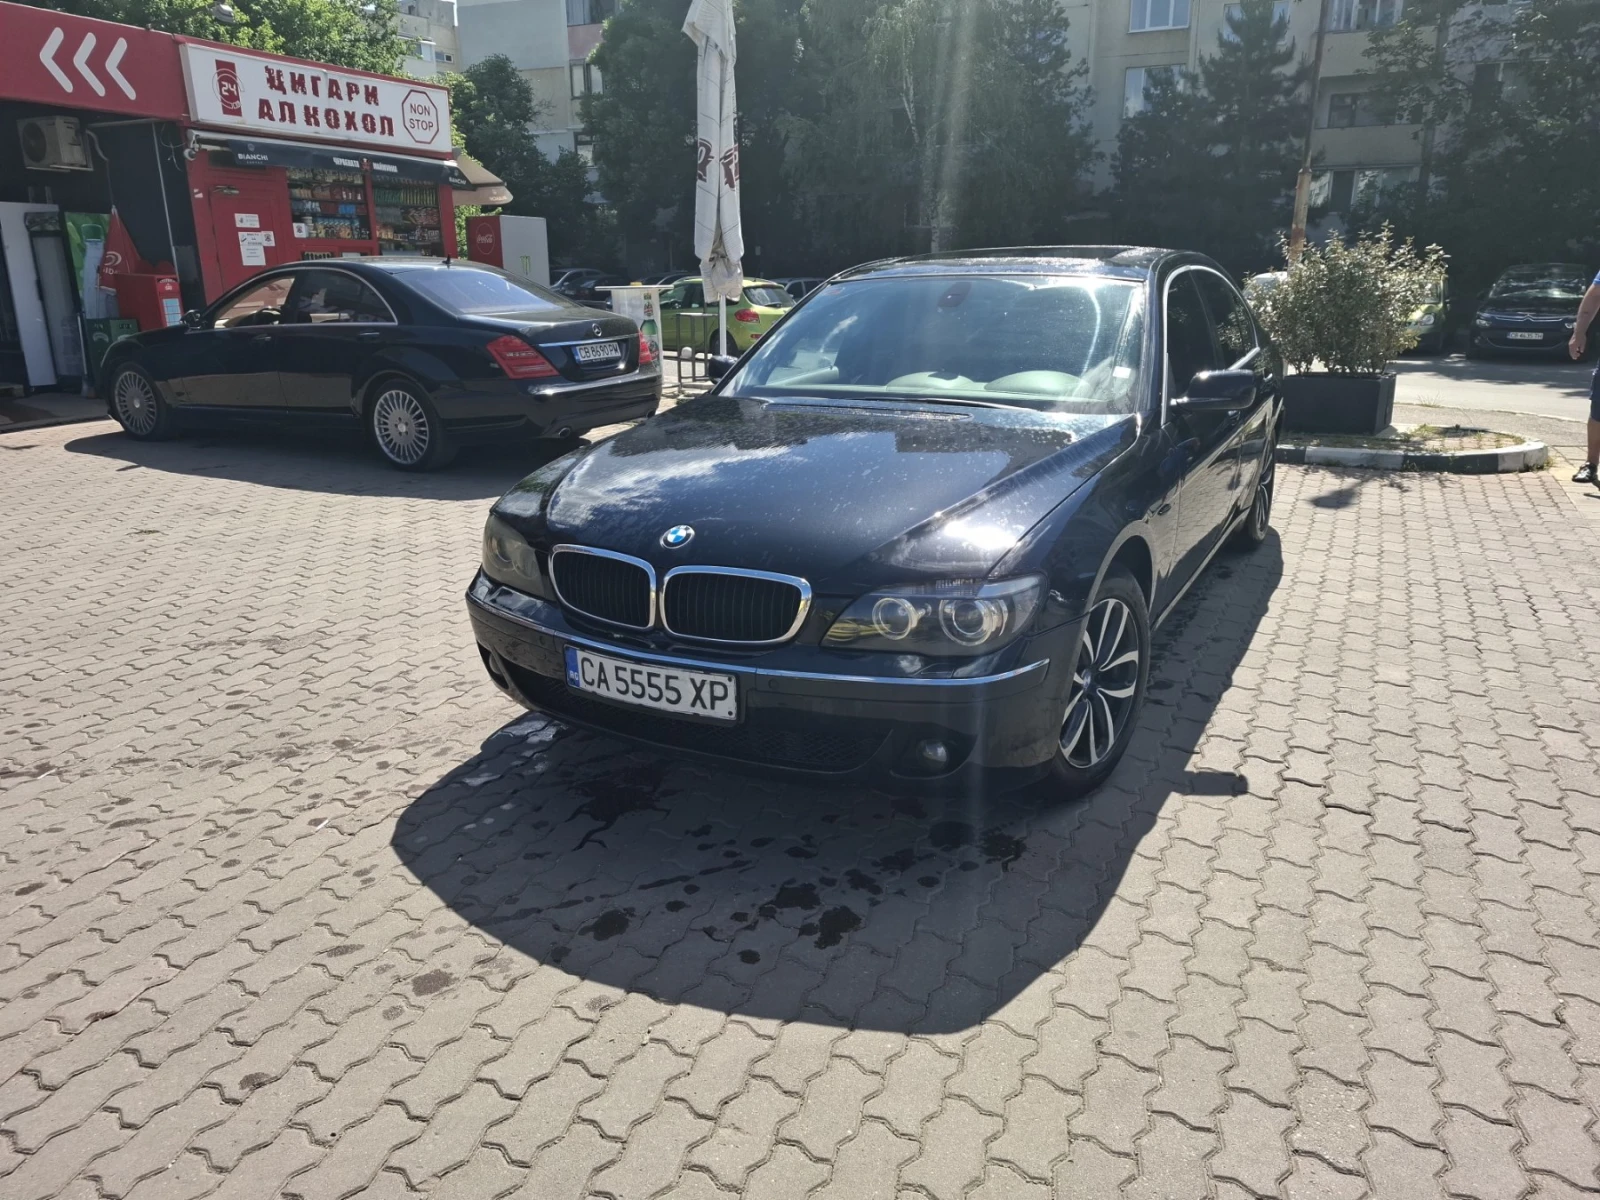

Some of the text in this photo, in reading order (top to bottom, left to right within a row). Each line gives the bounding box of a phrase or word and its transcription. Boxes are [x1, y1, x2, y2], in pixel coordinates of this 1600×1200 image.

[220, 81, 238, 96] 24
[264, 65, 379, 106] ЦИГАРИ
[258, 98, 394, 136] АЛКОХОЛ
[410, 103, 430, 116] NON
[409, 118, 434, 131] STOP
[237, 153, 269, 161] BIANCHI
[581, 657, 729, 711] CA 5555 XP
